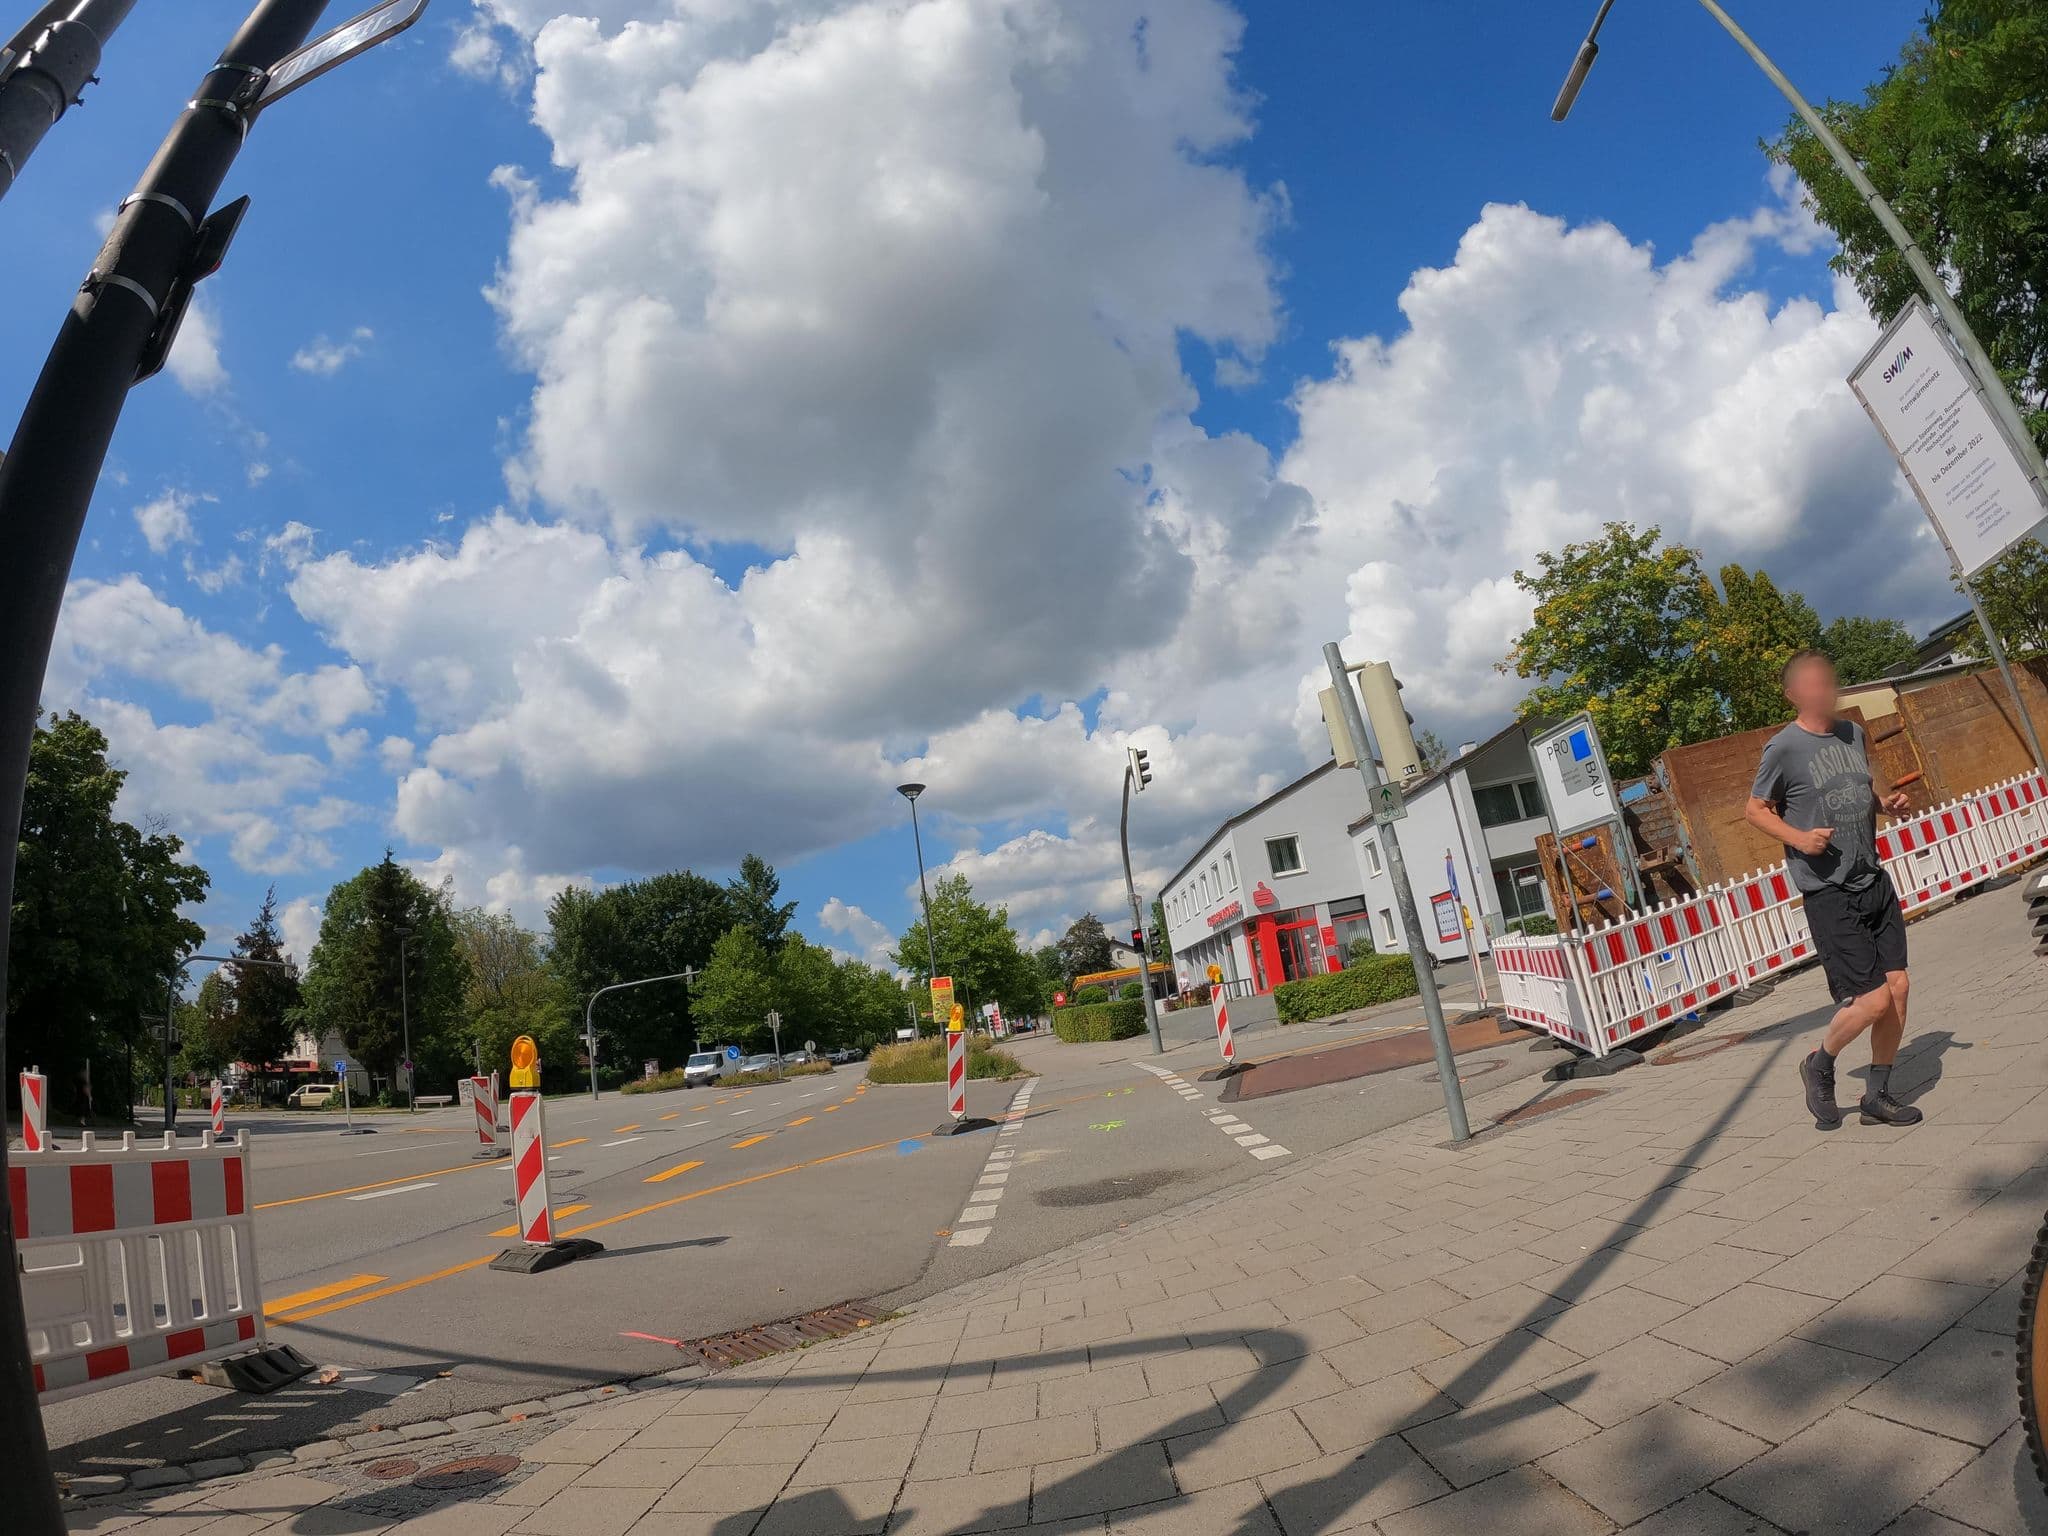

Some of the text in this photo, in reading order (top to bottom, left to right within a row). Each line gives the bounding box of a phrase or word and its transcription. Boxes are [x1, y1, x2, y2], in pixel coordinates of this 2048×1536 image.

[1900, 369, 1941, 415] Fernwärmenetz
[1931, 472, 1941, 484] bis
[1940, 446, 1969, 475] Dezember
[1967, 432, 1984, 450] 2022
[1546, 739, 1569, 761] PRO
[1808, 744, 1868, 790] GASOLIN
[1585, 760, 1605, 797] BAU
